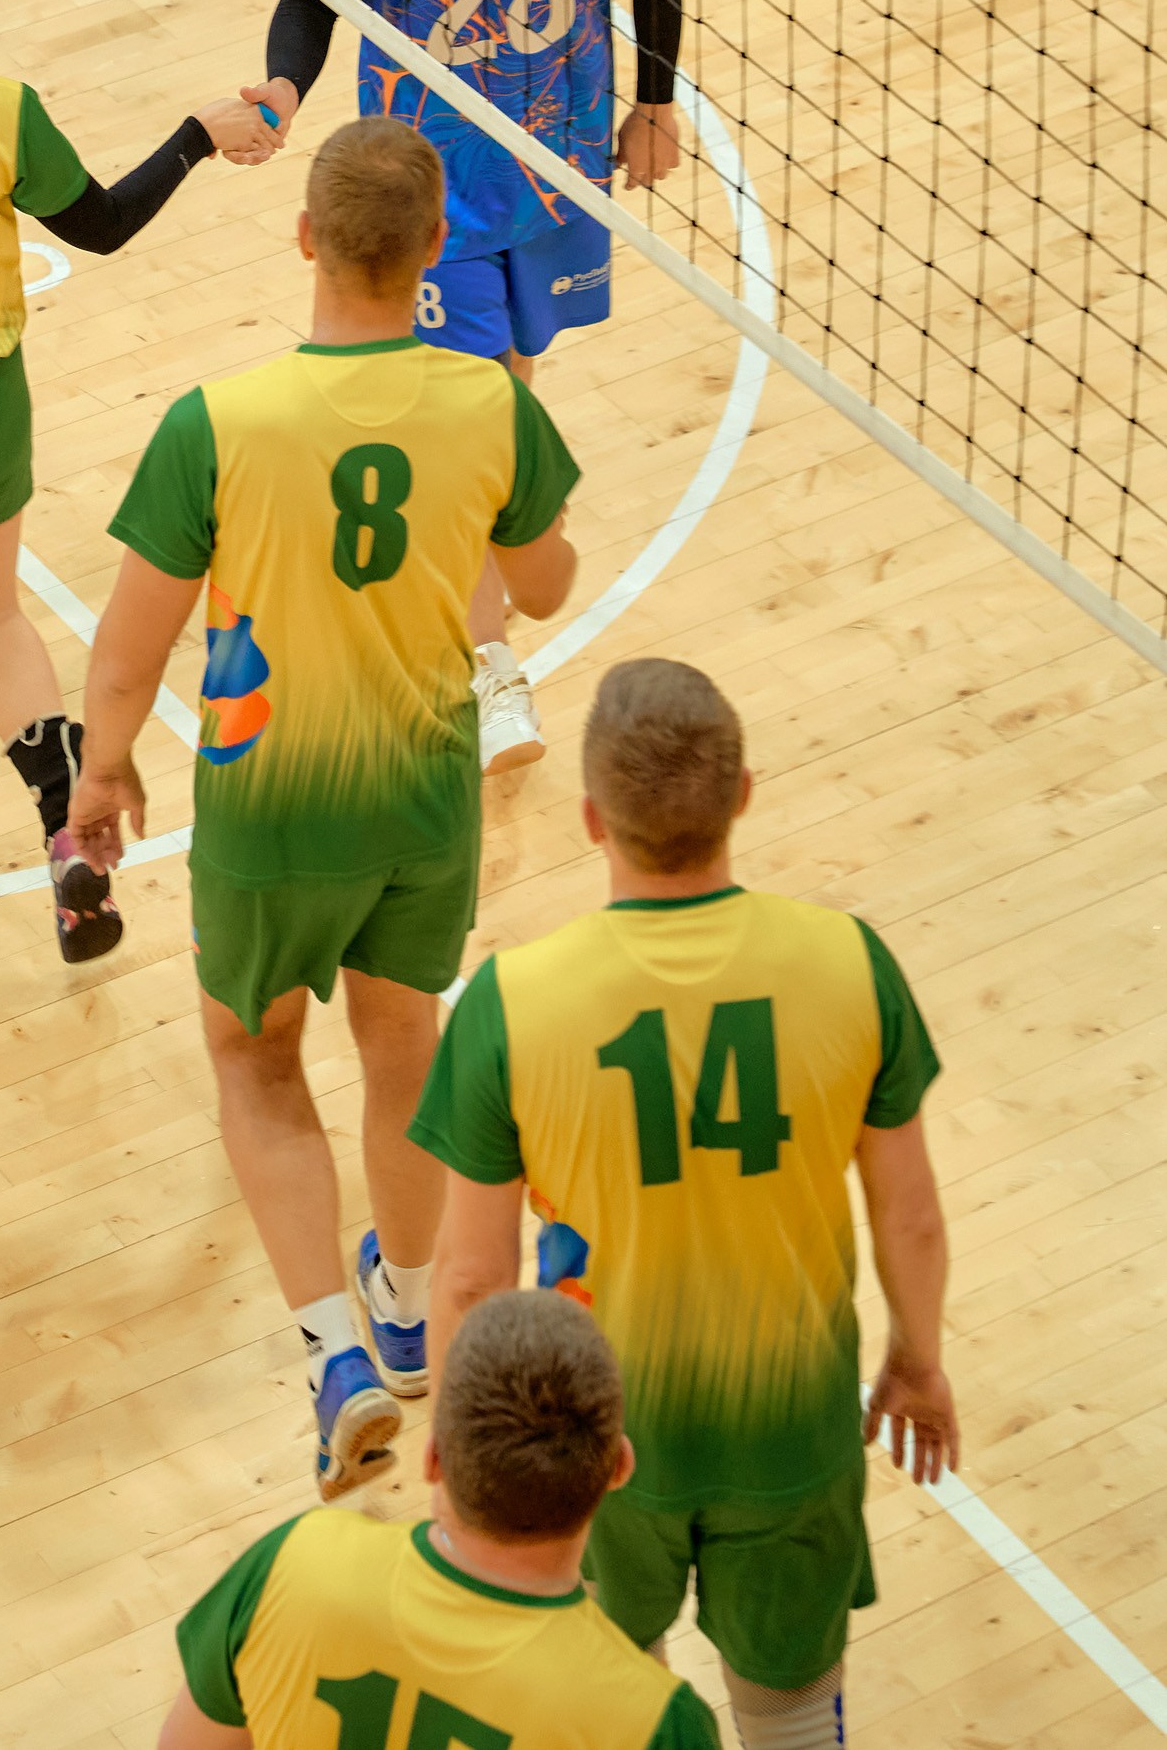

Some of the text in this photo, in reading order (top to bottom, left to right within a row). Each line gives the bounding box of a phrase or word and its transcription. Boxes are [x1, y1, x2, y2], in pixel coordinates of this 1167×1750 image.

[414, 282, 447, 329] 8
[331, 442, 412, 592] 8
[596, 996, 791, 1187] 14
